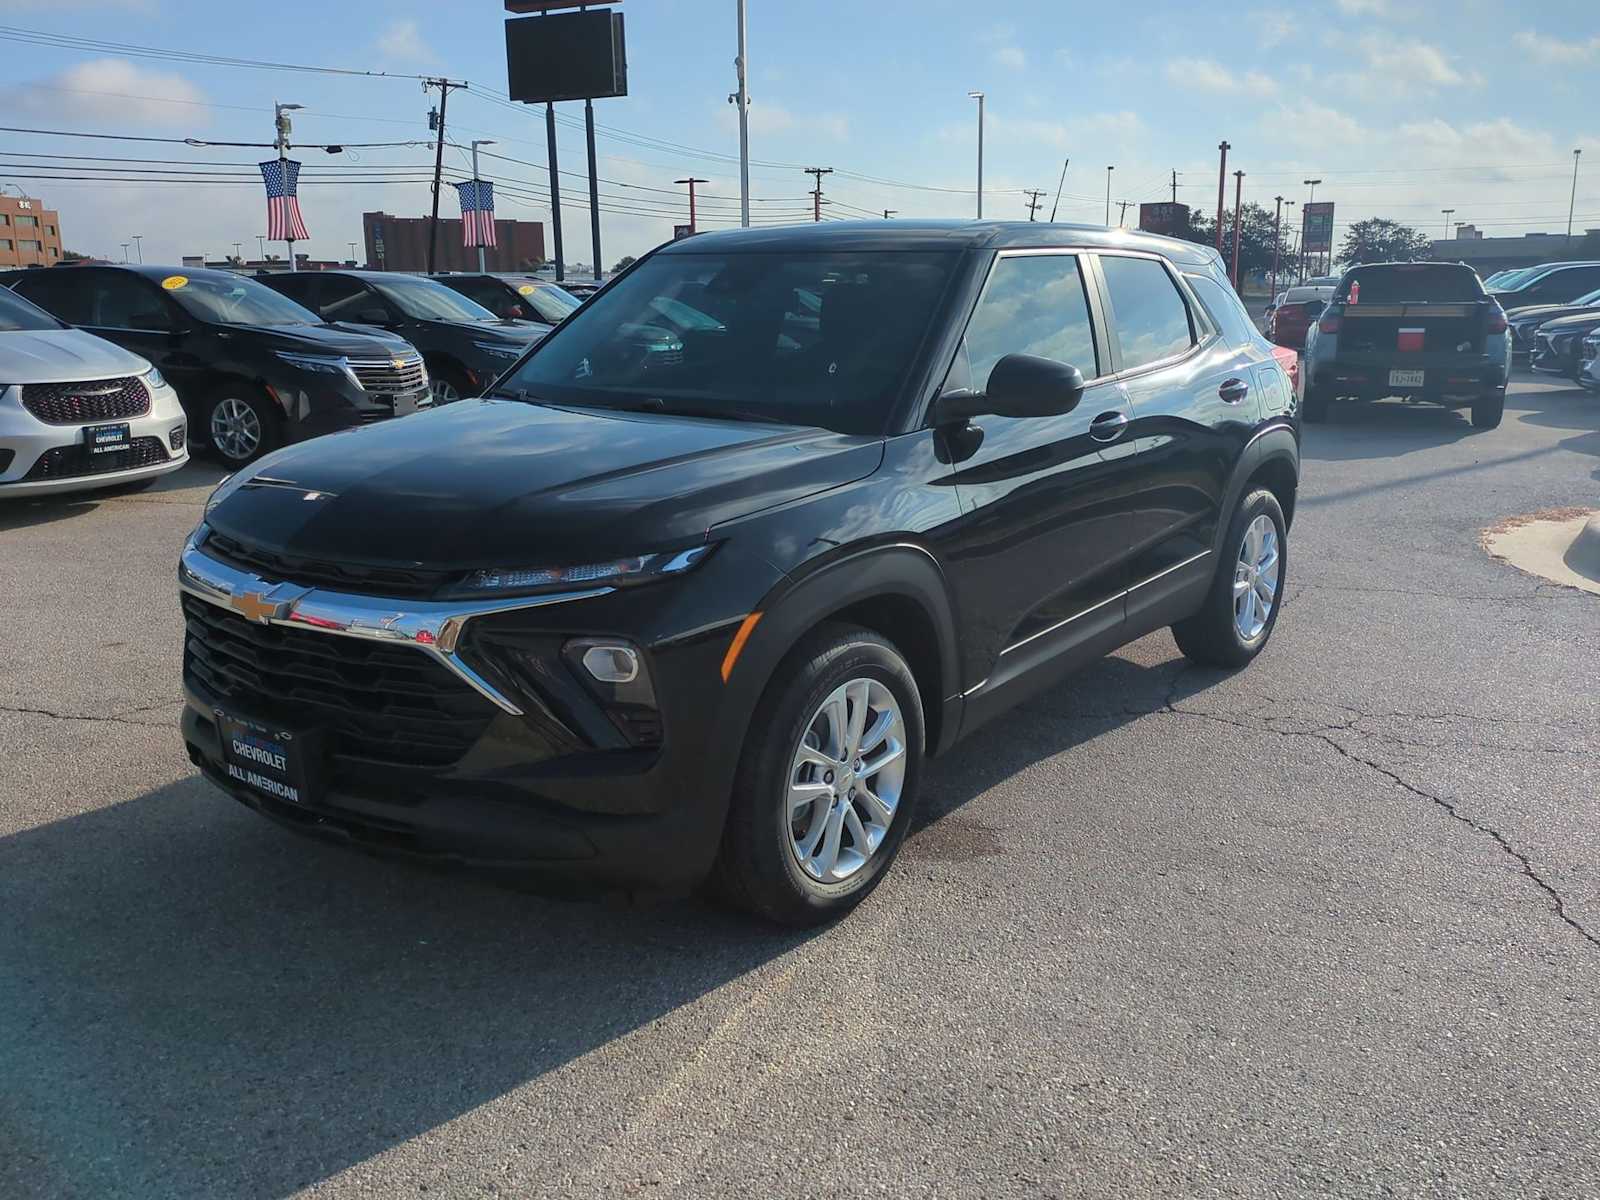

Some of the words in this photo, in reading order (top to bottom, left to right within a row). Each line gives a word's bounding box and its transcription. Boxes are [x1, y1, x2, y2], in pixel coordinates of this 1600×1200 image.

[232, 740, 286, 771] CHEVROLET
[229, 764, 246, 781] ALL
[247, 771, 298, 802] AMERICAN
